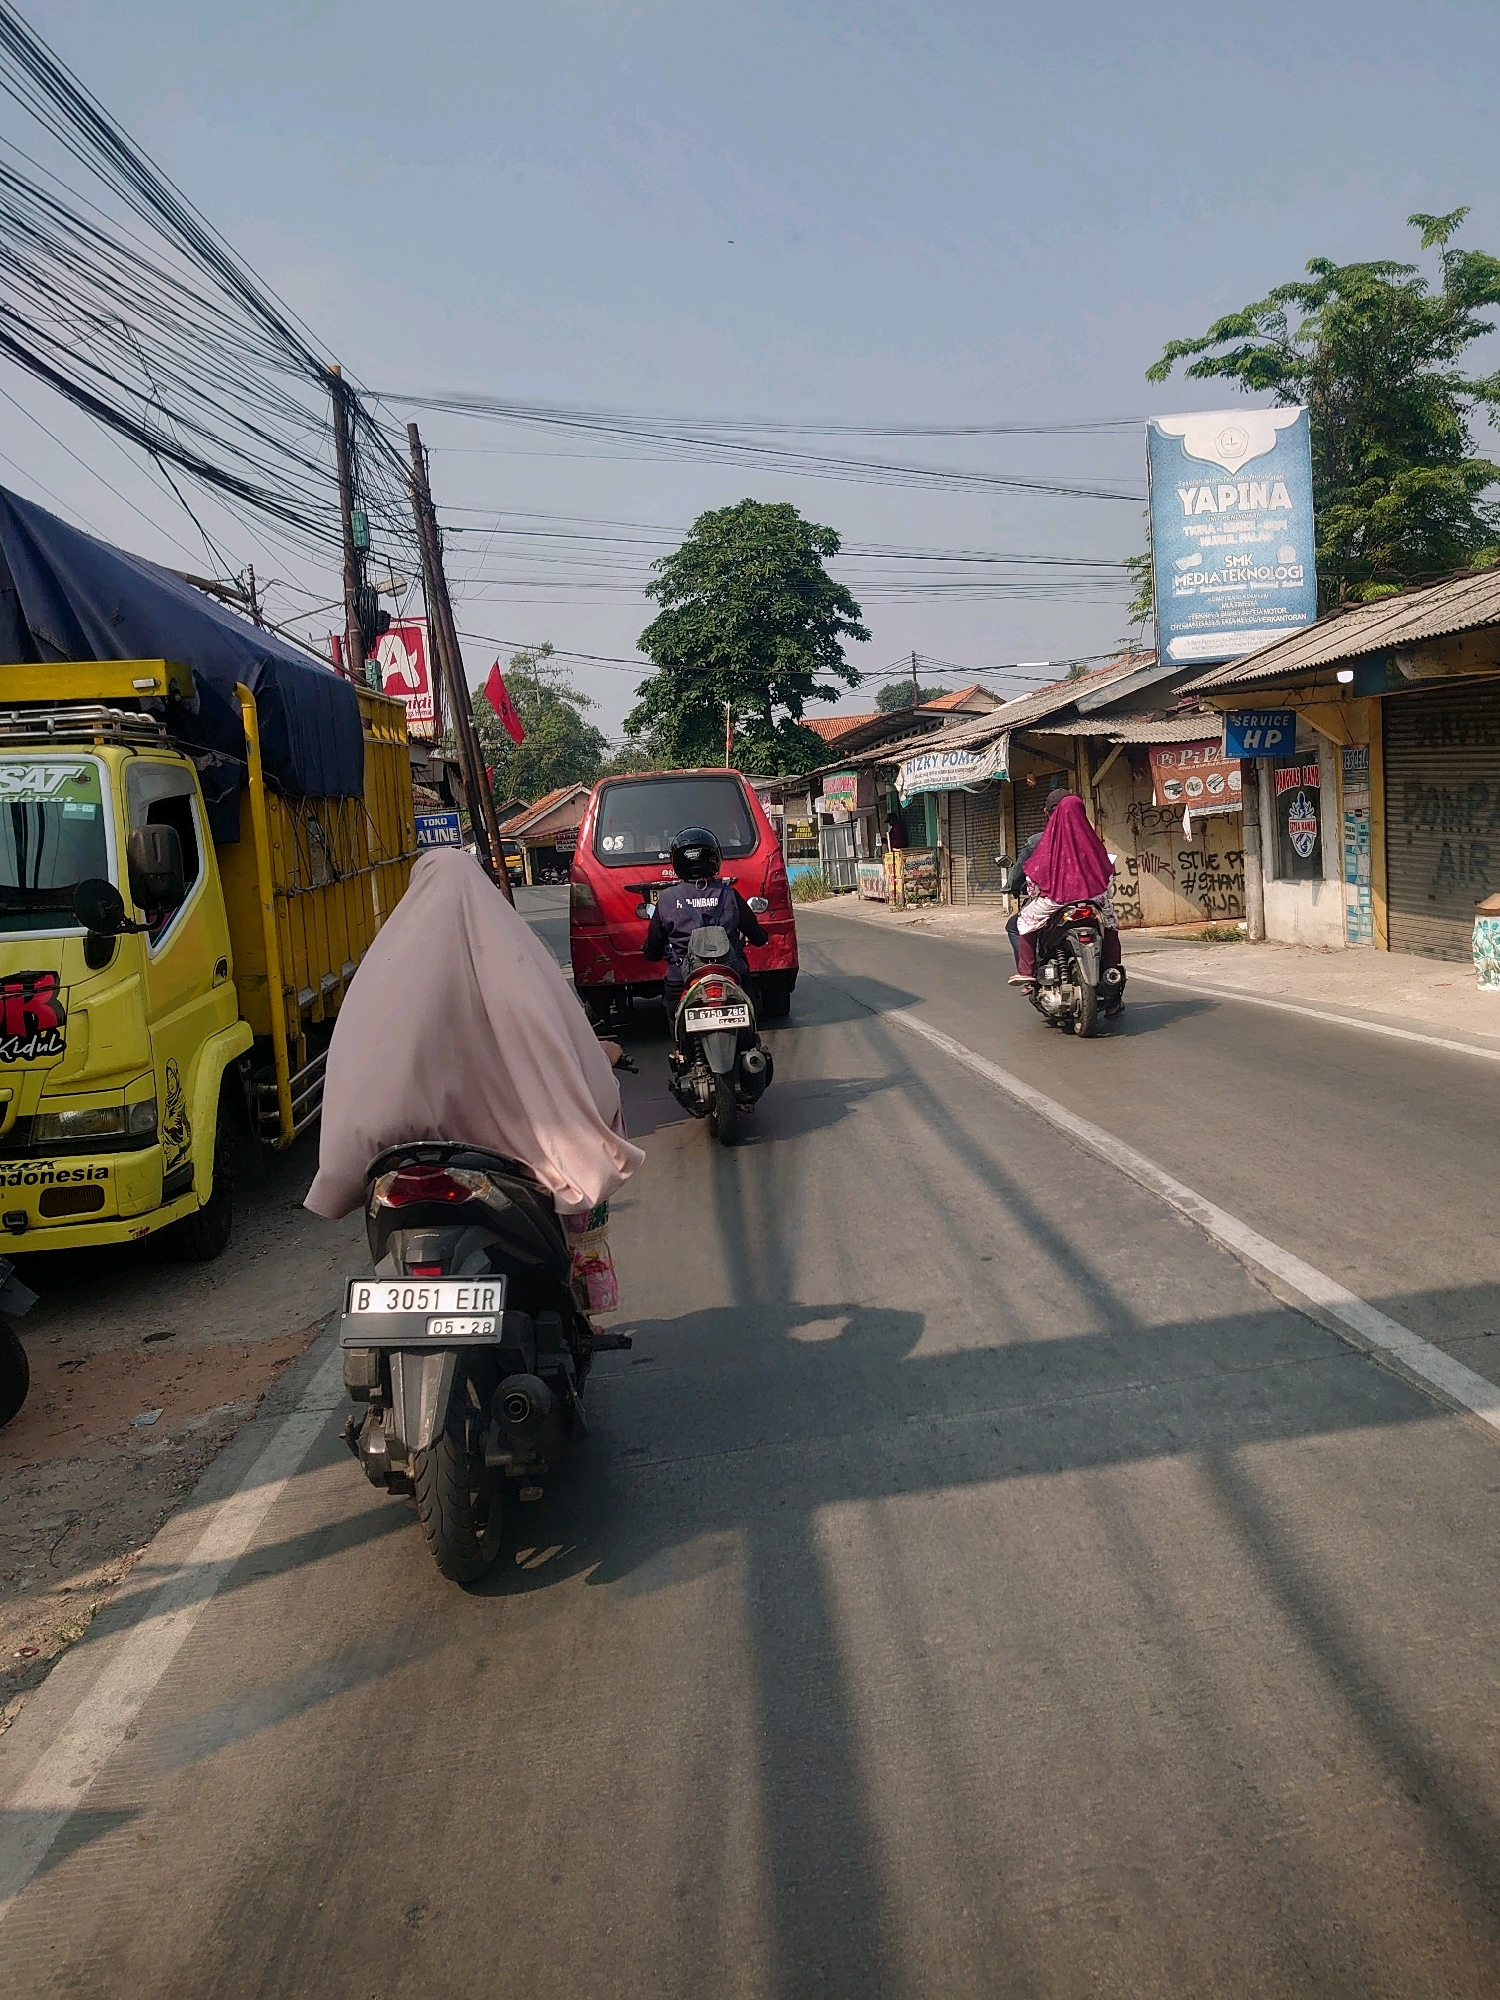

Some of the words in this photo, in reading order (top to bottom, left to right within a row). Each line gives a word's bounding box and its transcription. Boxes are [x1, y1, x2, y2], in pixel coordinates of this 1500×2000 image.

[1177, 482, 1293, 515] YAPINA
[1224, 553, 1253, 568] SMK
[1174, 565, 1304, 587] MEDIATEKNOLOGI
[1264, 607, 1287, 616] MOTOR
[1233, 715, 1290, 727] SERVICE
[1243, 729, 1282, 749] HP
[906, 753, 939, 776] RIZKY
[0, 766, 86, 796] SAT
[422, 817, 448, 827] TOKO
[417, 827, 460, 845] ALINE
[689, 1011, 695, 1020] B
[700, 1009, 722, 1019] 6750
[727, 1007, 745, 1017] ZBC
[357, 1289, 370, 1311] B
[386, 1288, 441, 1311] 3051
[456, 1288, 495, 1311] EIR
